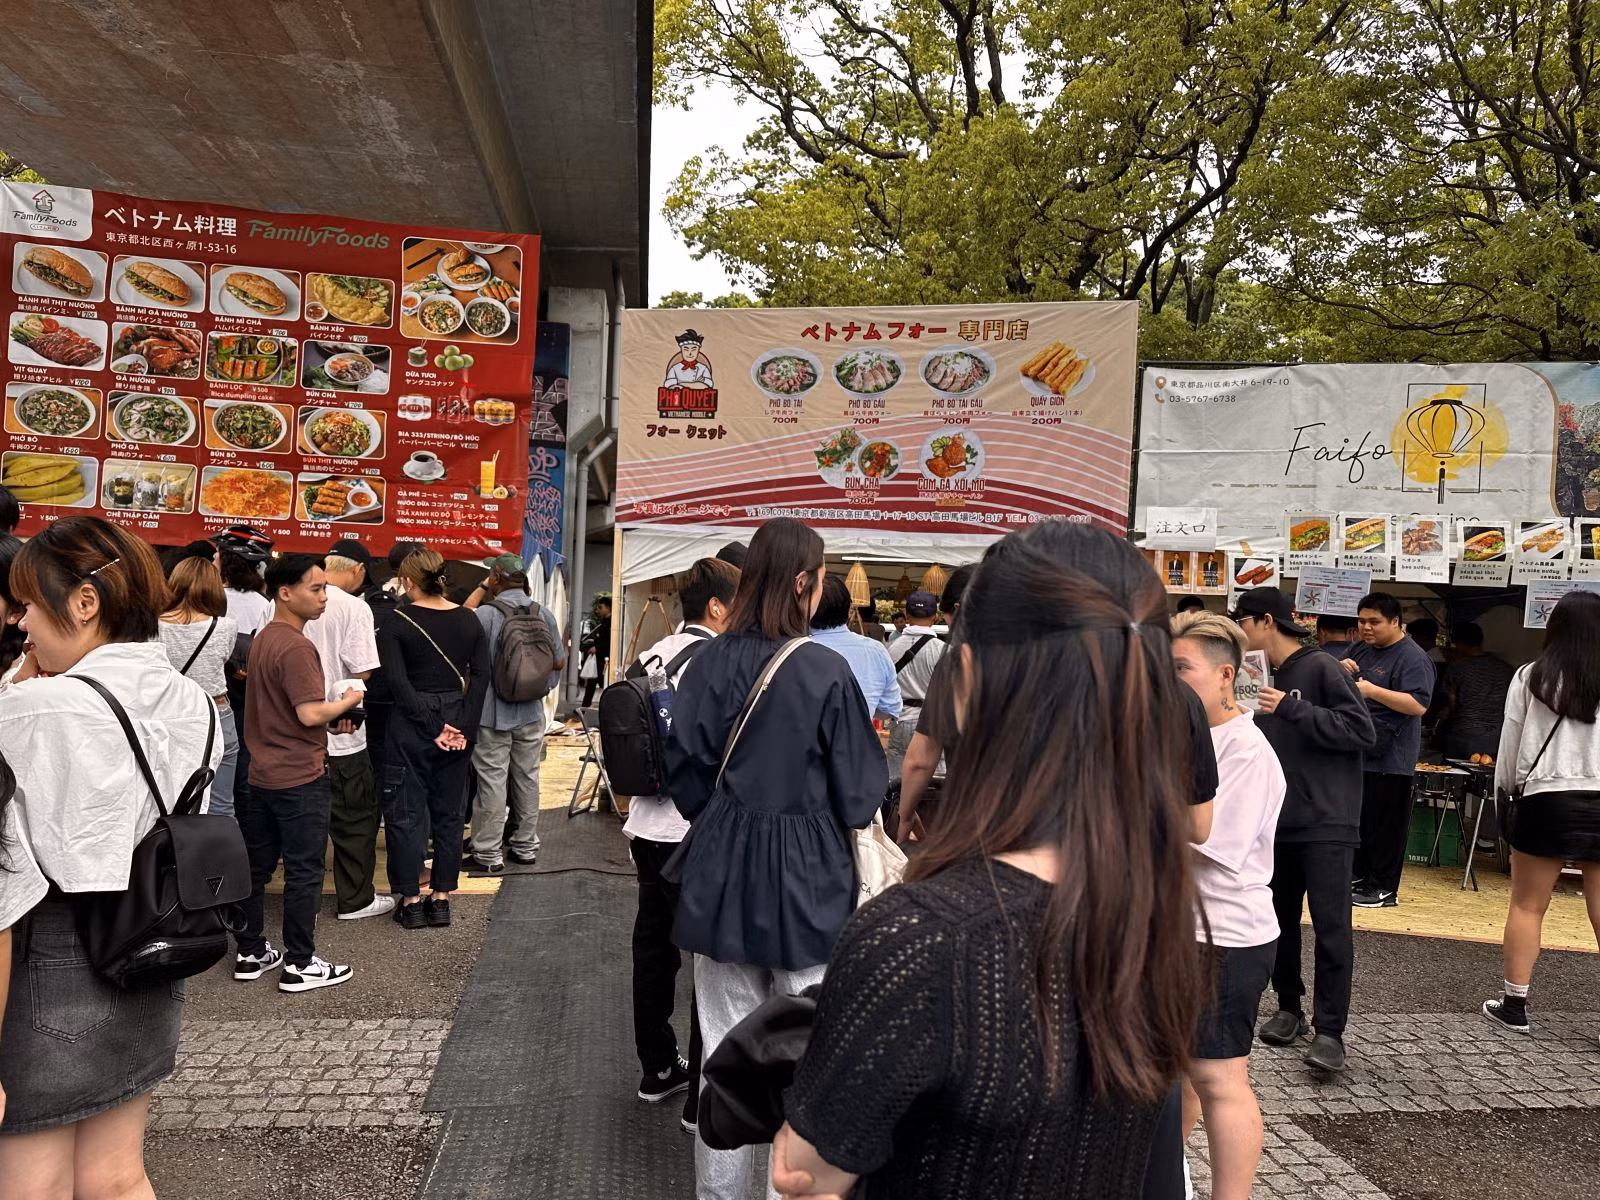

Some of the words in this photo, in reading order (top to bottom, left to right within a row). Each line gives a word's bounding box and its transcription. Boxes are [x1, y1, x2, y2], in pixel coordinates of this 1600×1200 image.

[11, 210, 78, 227] FamilyFoods
[104, 207, 237, 237] ベトナム料理
[246, 219, 391, 250] FamilyFoods
[801, 321, 947, 342] ベトナムフォー
[957, 318, 1030, 342] 専門店
[27, 366, 48, 374] QUAY
[225, 392, 257, 400] dumpling
[1169, 395, 1236, 403] 03-5767-6738
[942, 417, 971, 425] 700円
[1031, 417, 1062, 425] 200円
[646, 424, 681, 438] フォー
[686, 424, 727, 440] クェット
[1285, 422, 1393, 484] Faifo
[1155, 521, 1207, 535] 注文口
